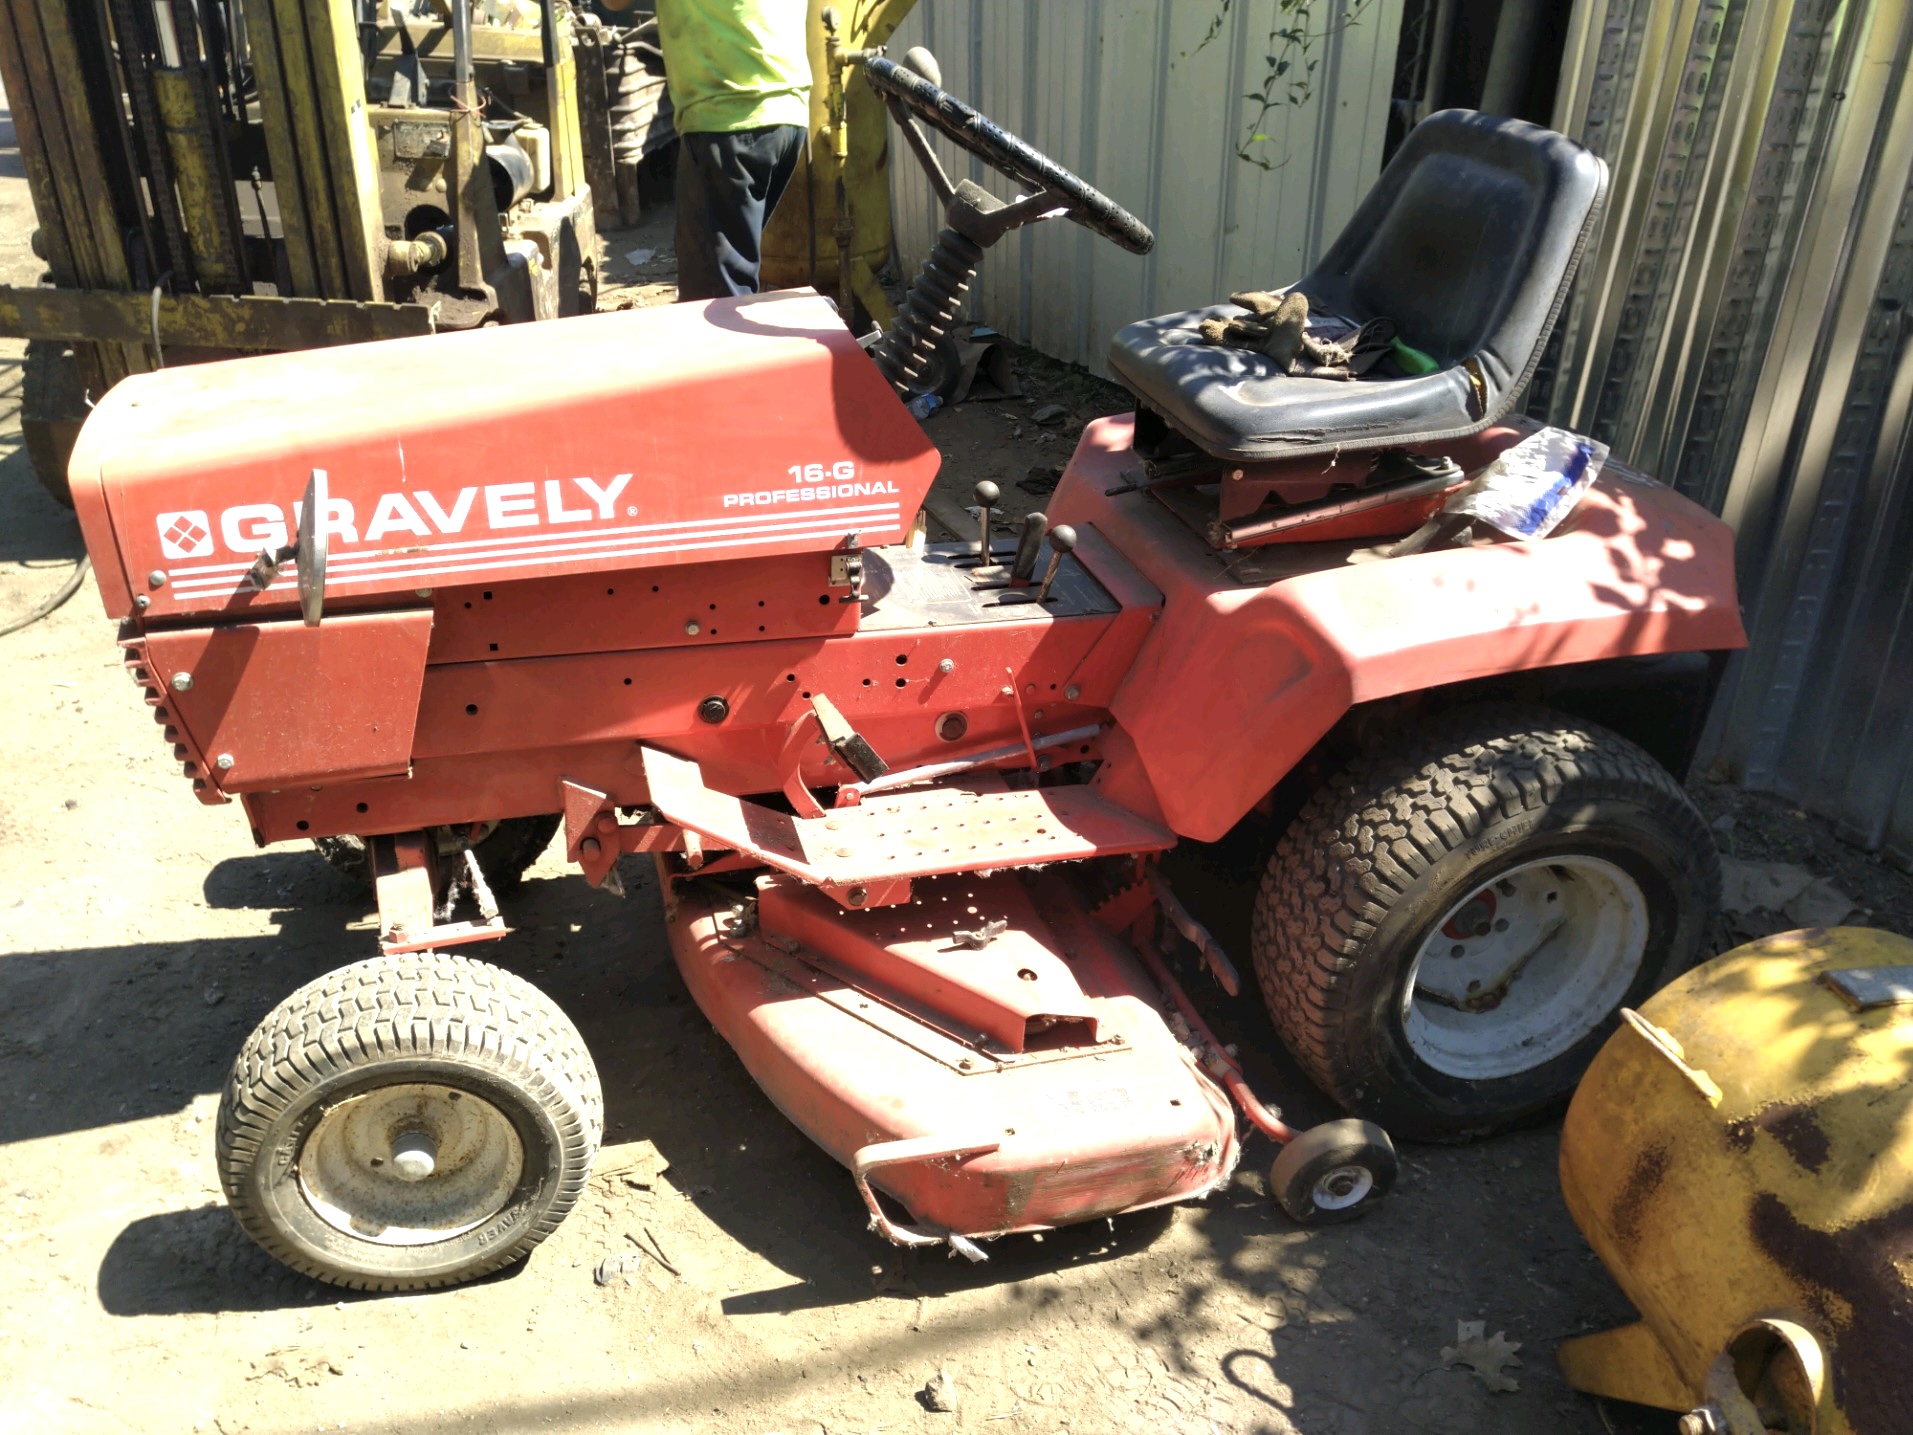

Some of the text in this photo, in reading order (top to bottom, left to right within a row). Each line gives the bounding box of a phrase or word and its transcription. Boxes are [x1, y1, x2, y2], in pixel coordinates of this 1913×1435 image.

[788, 461, 855, 483] 16-G
[723, 481, 900, 508] PROFESSIONAL
[220, 474, 634, 553] GRAVELY
